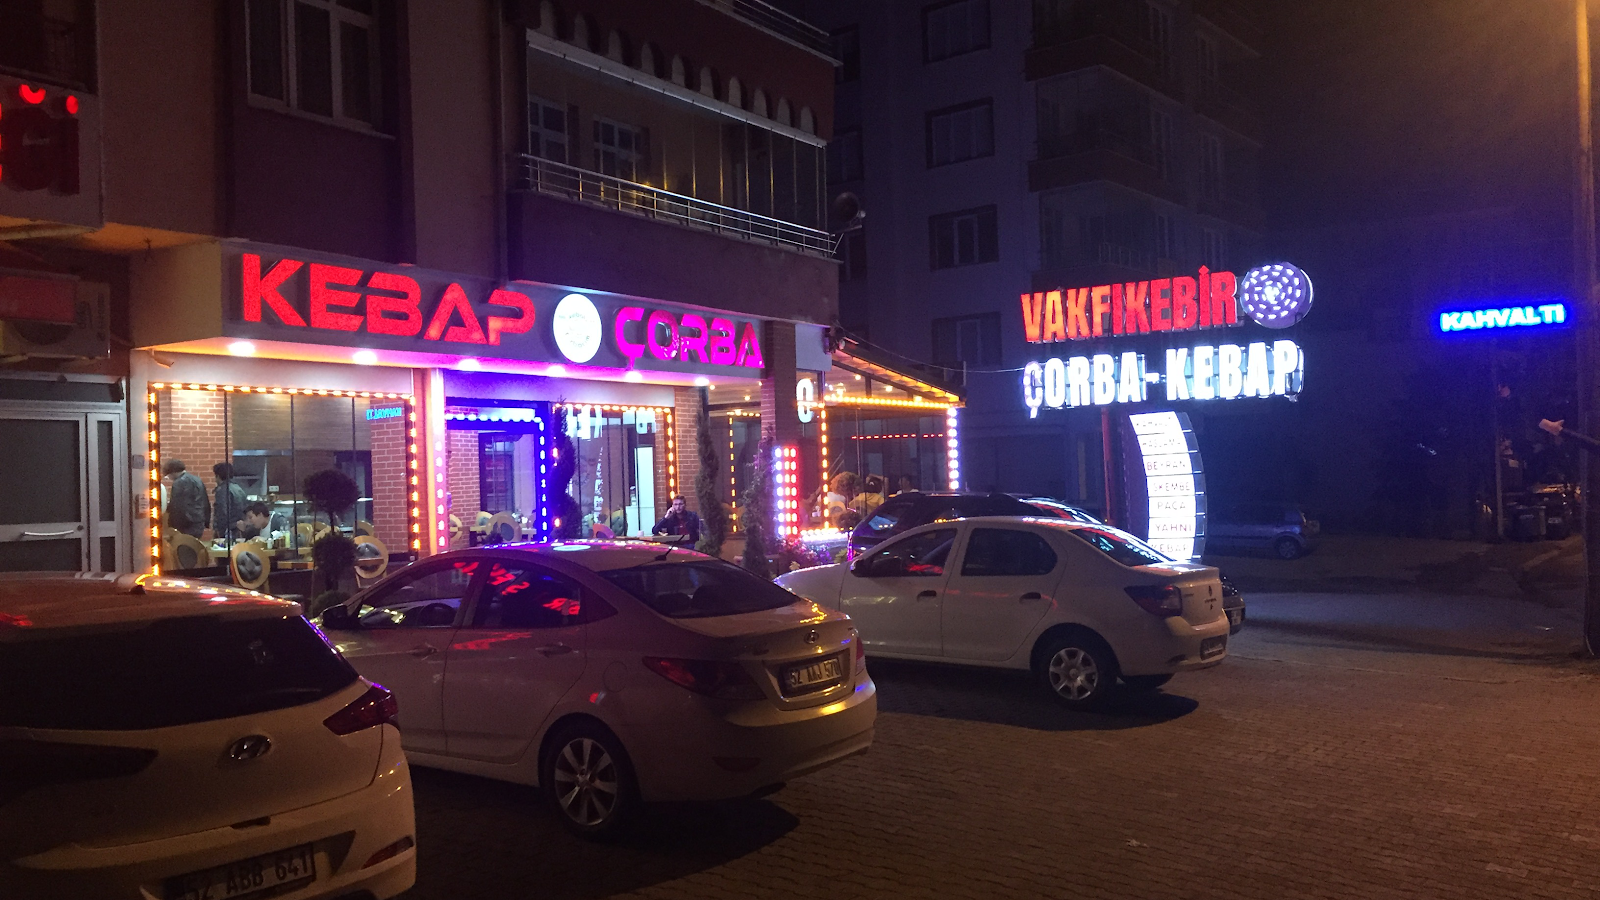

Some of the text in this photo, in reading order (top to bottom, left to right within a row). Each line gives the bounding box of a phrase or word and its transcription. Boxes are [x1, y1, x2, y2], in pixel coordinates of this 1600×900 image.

[243, 253, 536, 346] KEBAP
[1021, 265, 1238, 343] VAKFIKEBİR
[1440, 303, 1566, 332] KAHVALTI
[615, 306, 765, 371] ÇORBA
[1166, 339, 1299, 401] KEBAP
[790, 669, 802, 686] 52
[226, 858, 264, 895] ABB
[275, 851, 308, 881] 641
